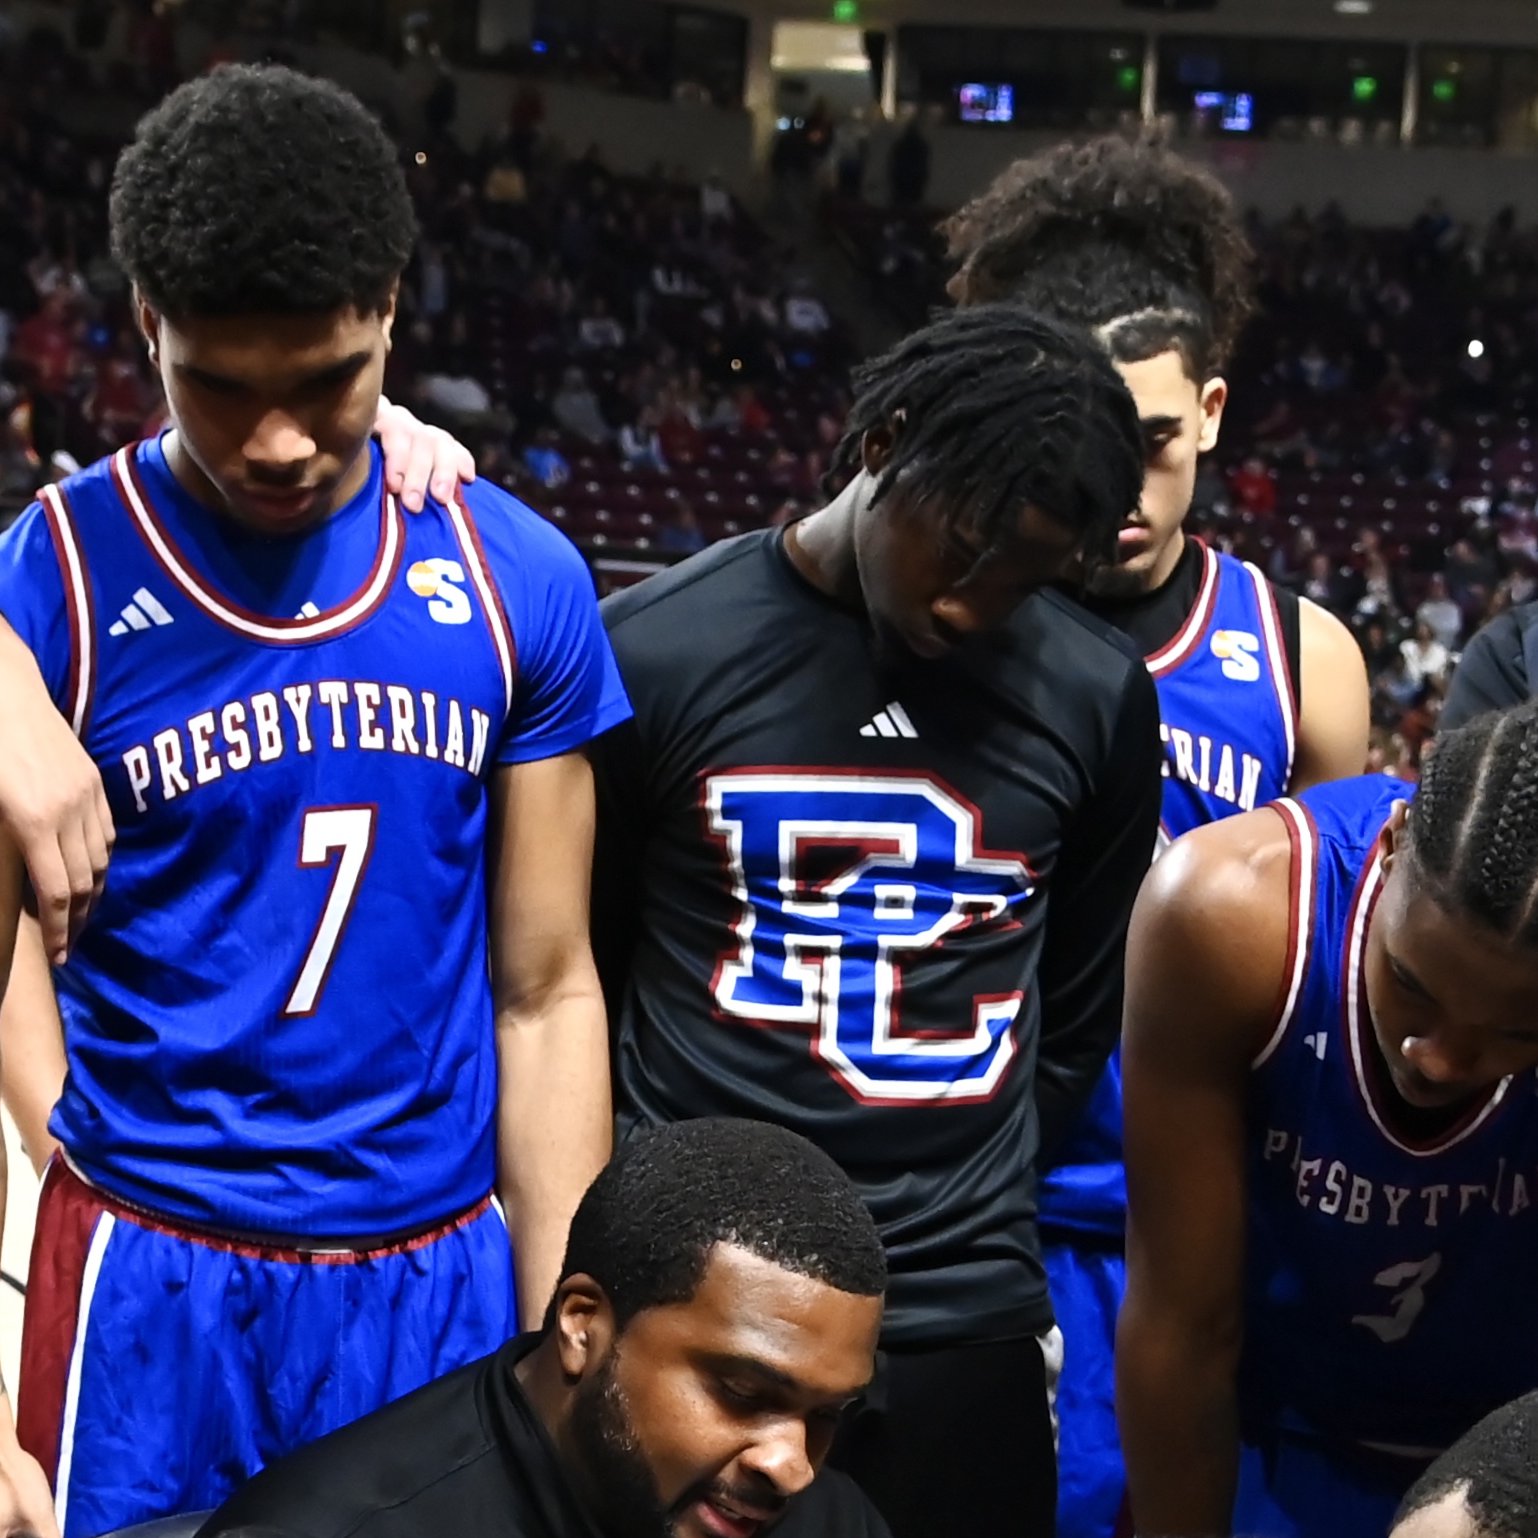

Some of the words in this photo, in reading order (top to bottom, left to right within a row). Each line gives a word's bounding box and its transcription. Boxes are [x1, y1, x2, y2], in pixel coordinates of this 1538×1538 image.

[122, 680, 490, 813] PRESBYTERIAN
[280, 803, 377, 1018] 7
[698, 765, 1037, 1106] PC
[1351, 1251, 1442, 1343] 3
